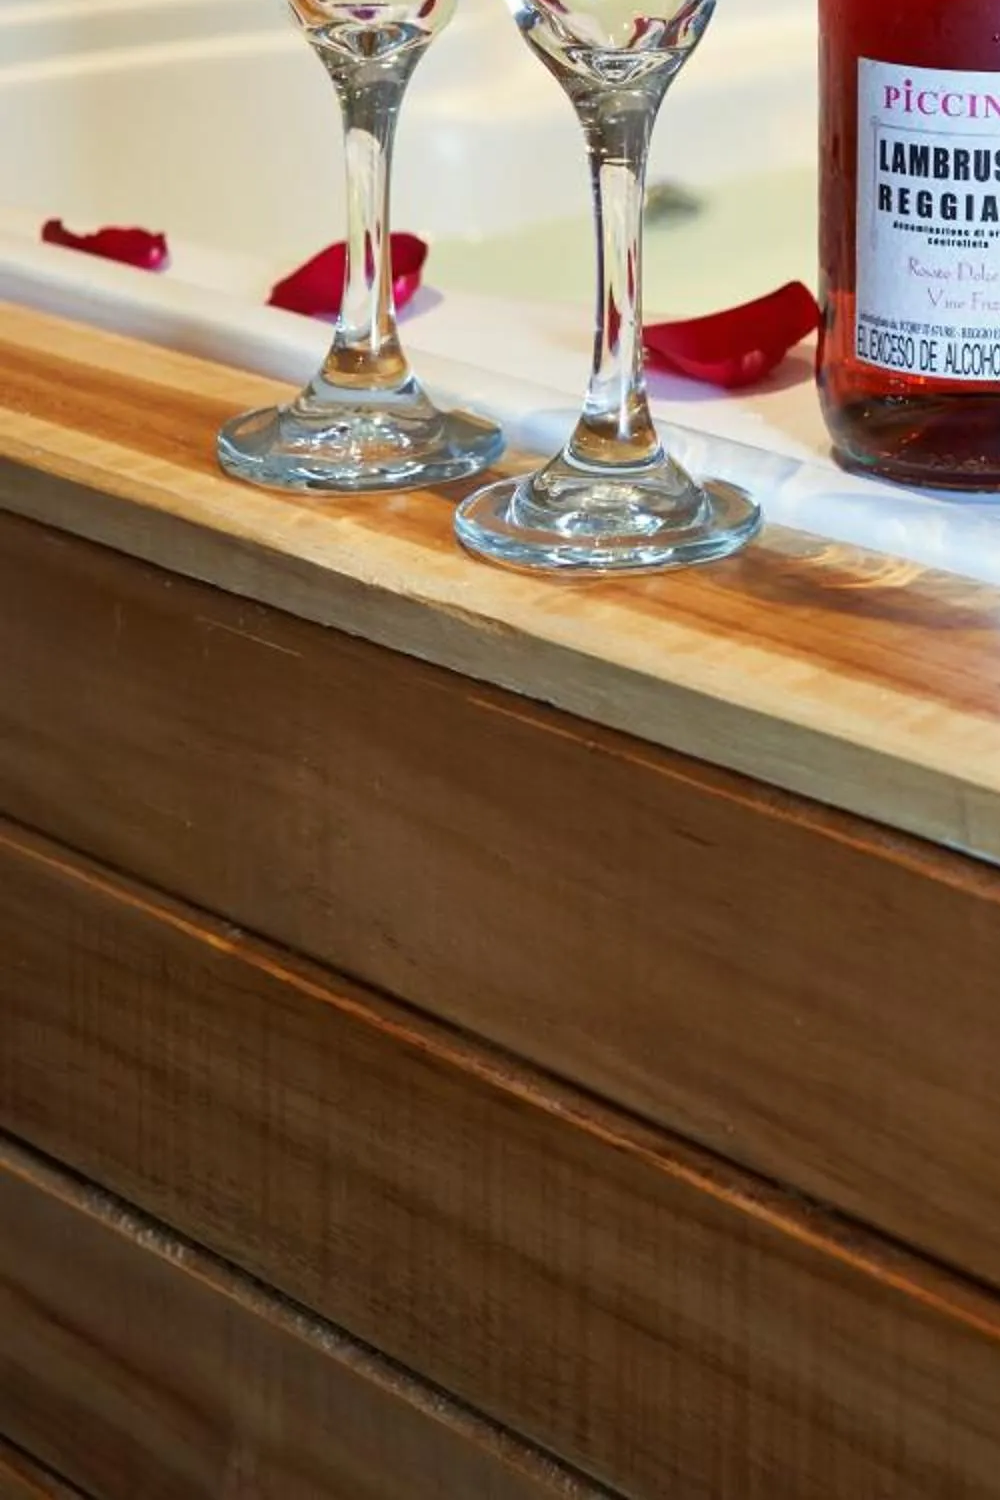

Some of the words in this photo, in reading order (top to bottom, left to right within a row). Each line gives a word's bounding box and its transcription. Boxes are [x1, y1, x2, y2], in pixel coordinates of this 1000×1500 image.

[893, 220, 970, 237] denominazione
[973, 226, 986, 238] di
[927, 236, 990, 250] controllata
[857, 326, 869, 358] EL
[869, 328, 915, 369] EXCESO
[919, 341, 937, 371] DE
